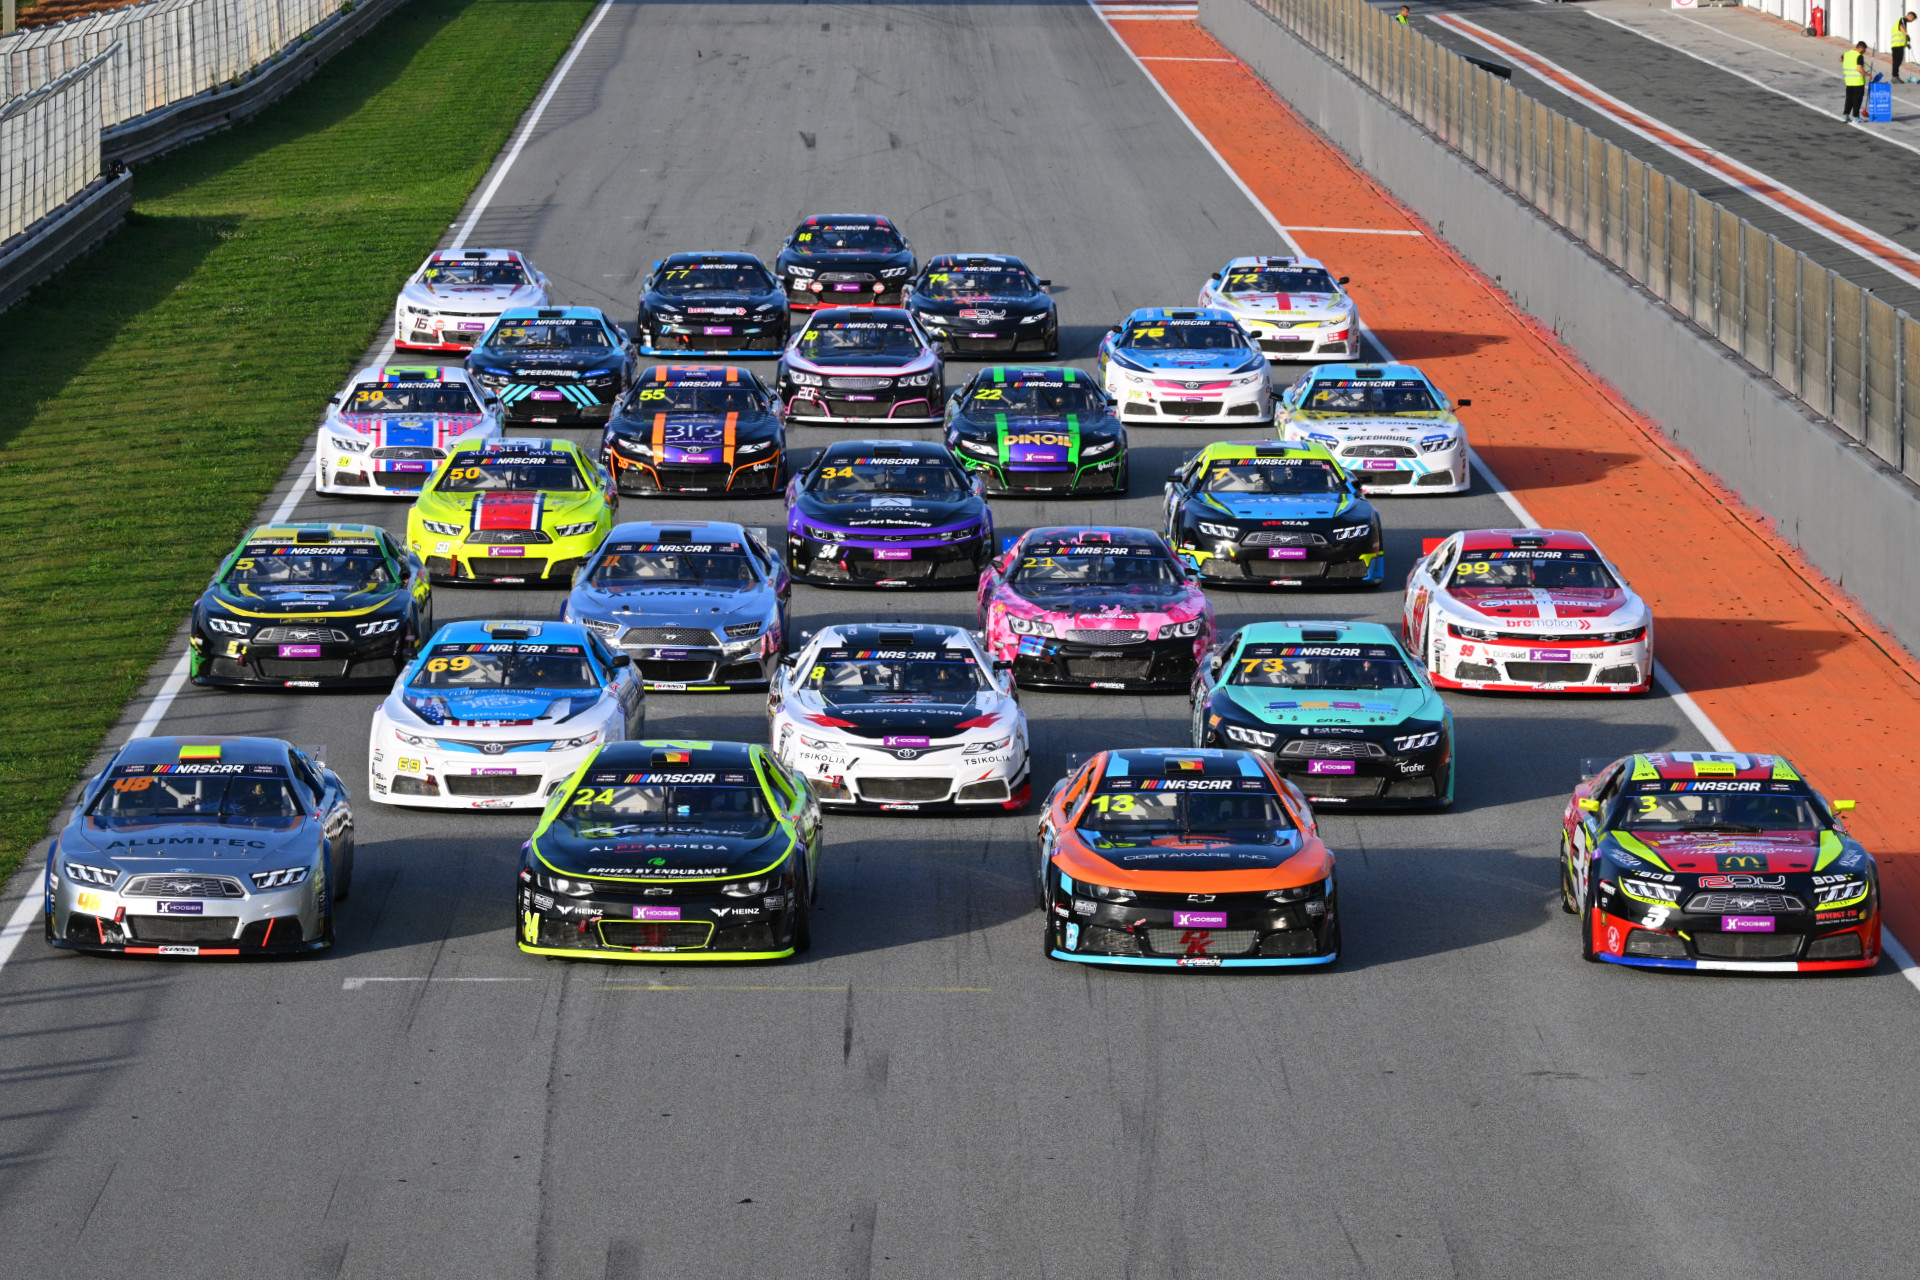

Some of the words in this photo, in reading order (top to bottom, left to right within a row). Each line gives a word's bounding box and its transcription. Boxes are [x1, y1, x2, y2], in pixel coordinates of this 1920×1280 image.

[798, 233, 812, 241] 86
[425, 269, 438, 277] 16
[666, 270, 690, 280] 77
[929, 273, 948, 283] 74
[793, 278, 807, 290] 86
[1230, 274, 1258, 284] 72
[414, 317, 429, 329] 16
[499, 329, 526, 337] 33
[660, 325, 671, 334] 77
[1133, 328, 1165, 339] 76
[804, 331, 818, 340] 20
[356, 391, 383, 401] 30
[640, 389, 665, 400] 55
[798, 386, 815, 399] 20
[974, 389, 1002, 400] 22
[1128, 390, 1142, 399] 76
[1314, 391, 1330, 401] 4
[1004, 434, 1072, 447] DINOIL
[337, 457, 351, 466] 30
[618, 460, 628, 469] 55
[965, 458, 977, 469] 22
[449, 468, 480, 479] 50
[821, 467, 854, 479] 34
[1212, 468, 1230, 480] 7
[435, 542, 450, 553] 50
[818, 544, 839, 558] 34
[235, 558, 255, 570] 5
[602, 556, 621, 566] 11
[1023, 558, 1055, 568] 21
[1456, 562, 1490, 575] 99
[227, 641, 238, 654] 5
[1018, 637, 1047, 655] 21
[1301, 647, 1360, 656] NASCAR
[1460, 644, 1474, 656] 99
[876, 651, 936, 659] NASCAR
[427, 656, 471, 672] 69
[1241, 659, 1284, 672] 73
[811, 667, 826, 678] 8
[800, 752, 846, 764] TSIKOLIA
[964, 756, 1010, 765] TSIKOLIA
[175, 764, 244, 774] NASCAR
[398, 758, 420, 772] 69
[647, 774, 715, 783] NASCAR
[113, 777, 155, 792] 48
[1162, 780, 1232, 789] NASCAR
[1693, 782, 1761, 791] NASCAR
[574, 789, 614, 805] 24
[1091, 795, 1136, 812] 13
[1639, 797, 1657, 812] 3
[105, 838, 266, 850] ALUMITEC
[78, 893, 101, 910] 48
[1642, 906, 1670, 929] 3
[524, 912, 540, 944] 24
